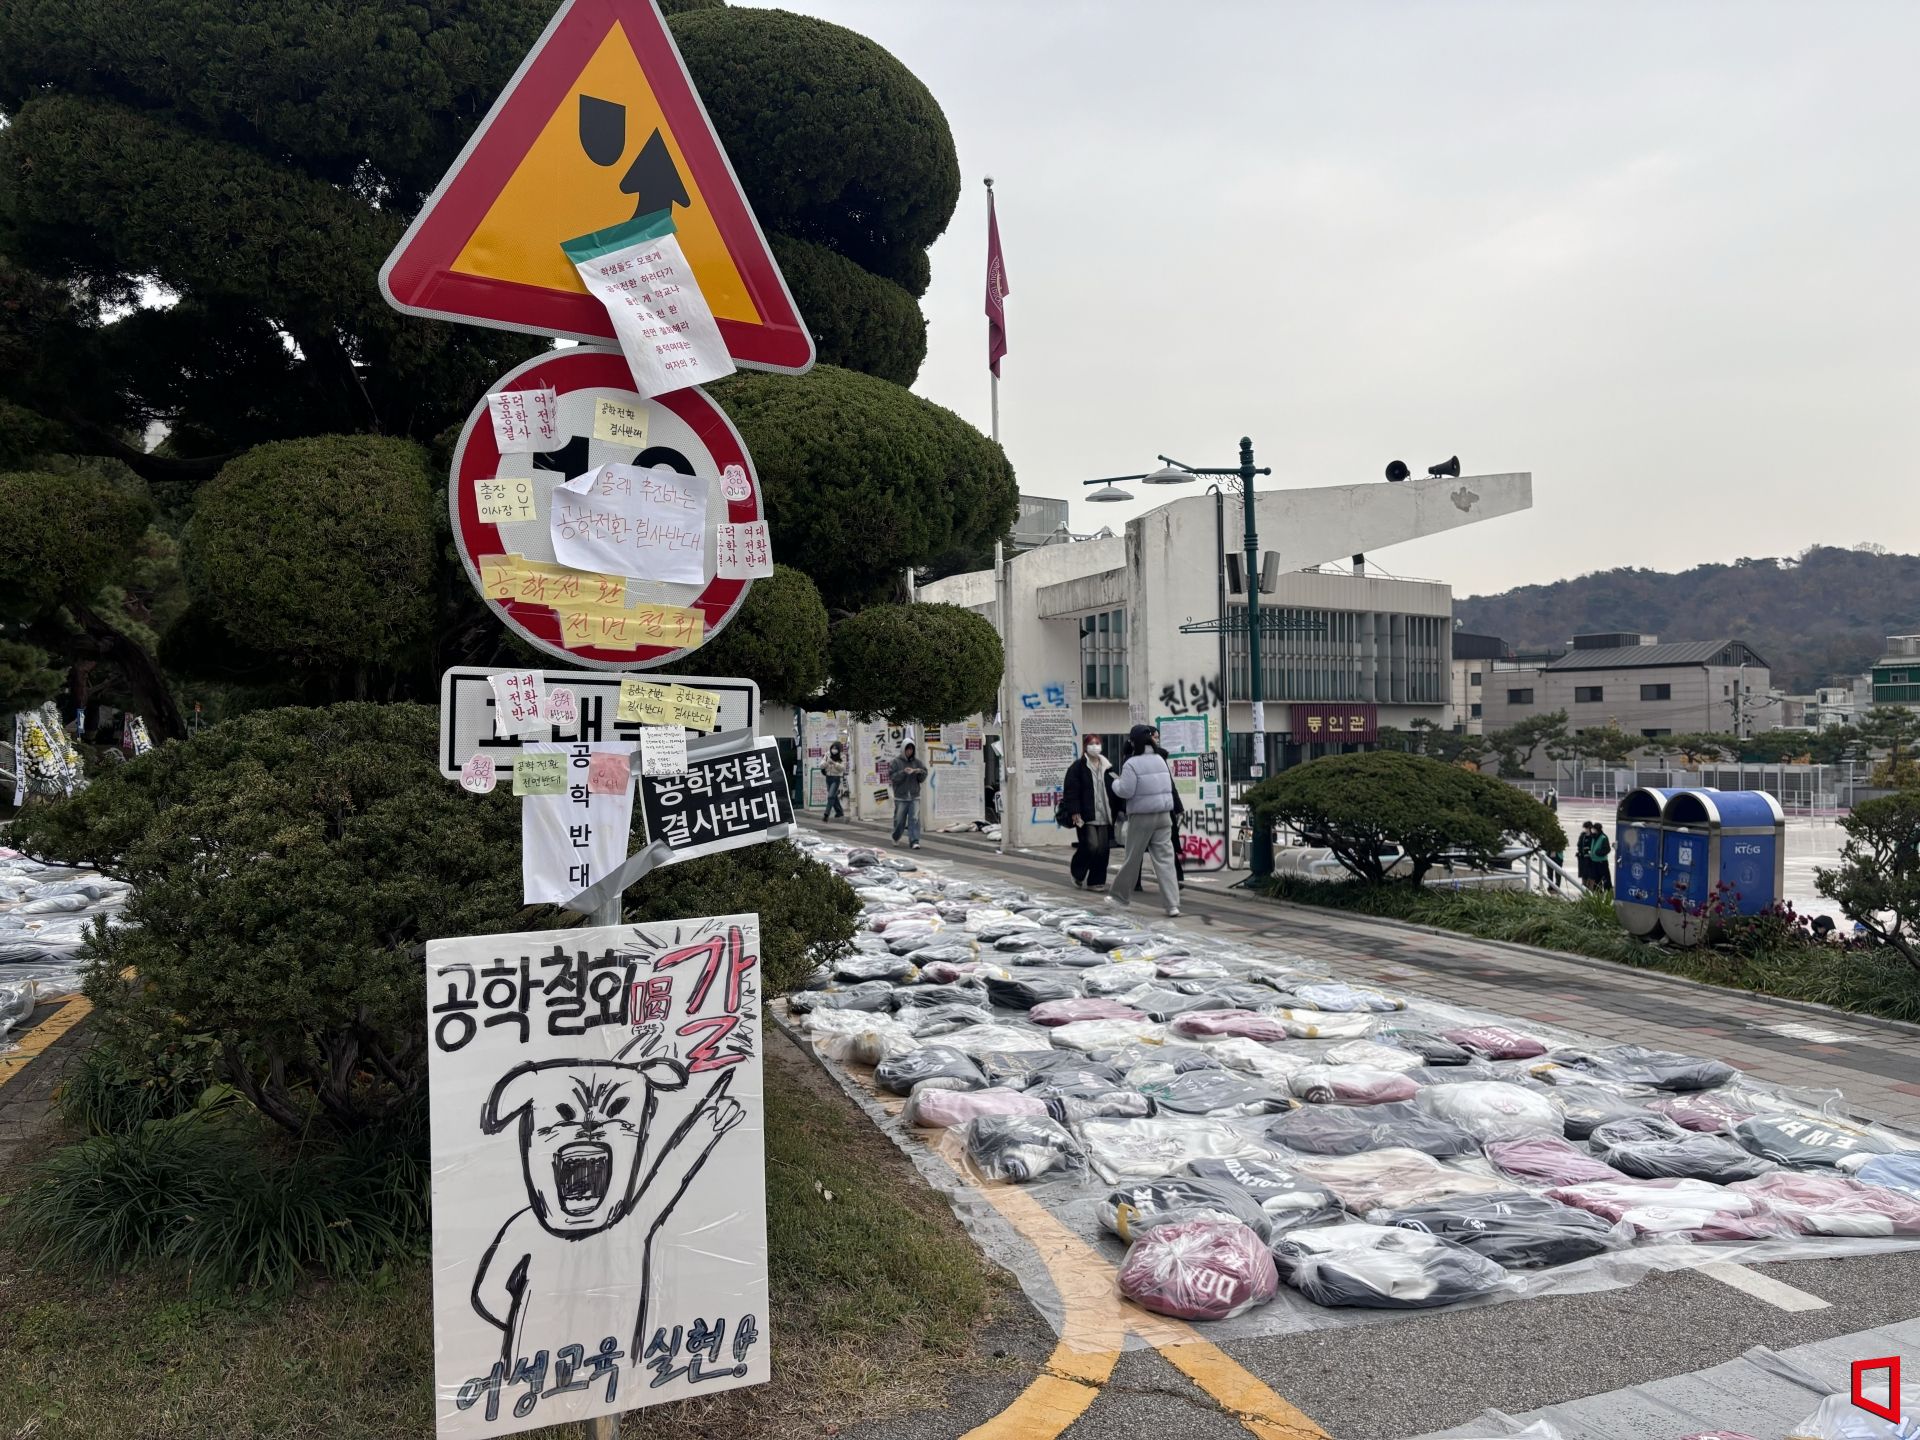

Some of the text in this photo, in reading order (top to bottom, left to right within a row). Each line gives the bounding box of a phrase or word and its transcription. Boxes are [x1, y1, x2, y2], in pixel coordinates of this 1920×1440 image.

[600, 251, 663, 277] 학생들도 모르게
[655, 341, 692, 355] 동덕여대는
[665, 356, 698, 371] 여자의 것
[480, 482, 506, 500] 총장
[639, 478, 697, 510] 추진하는
[481, 505, 513, 517] 이사장
[556, 505, 701, 551] 공학전환 결사반대
[506, 673, 535, 690] 여대
[509, 688, 538, 707] 전환
[511, 704, 539, 722] 반대
[1307, 715, 1365, 733] 동인관
[653, 752, 773, 807] 공학전환
[661, 790, 781, 847] 결사반대
[1735, 844, 1760, 855] KT&G
[432, 945, 637, 1053] 공학철회
[456, 1313, 759, 1422] 여성교육 실현!
